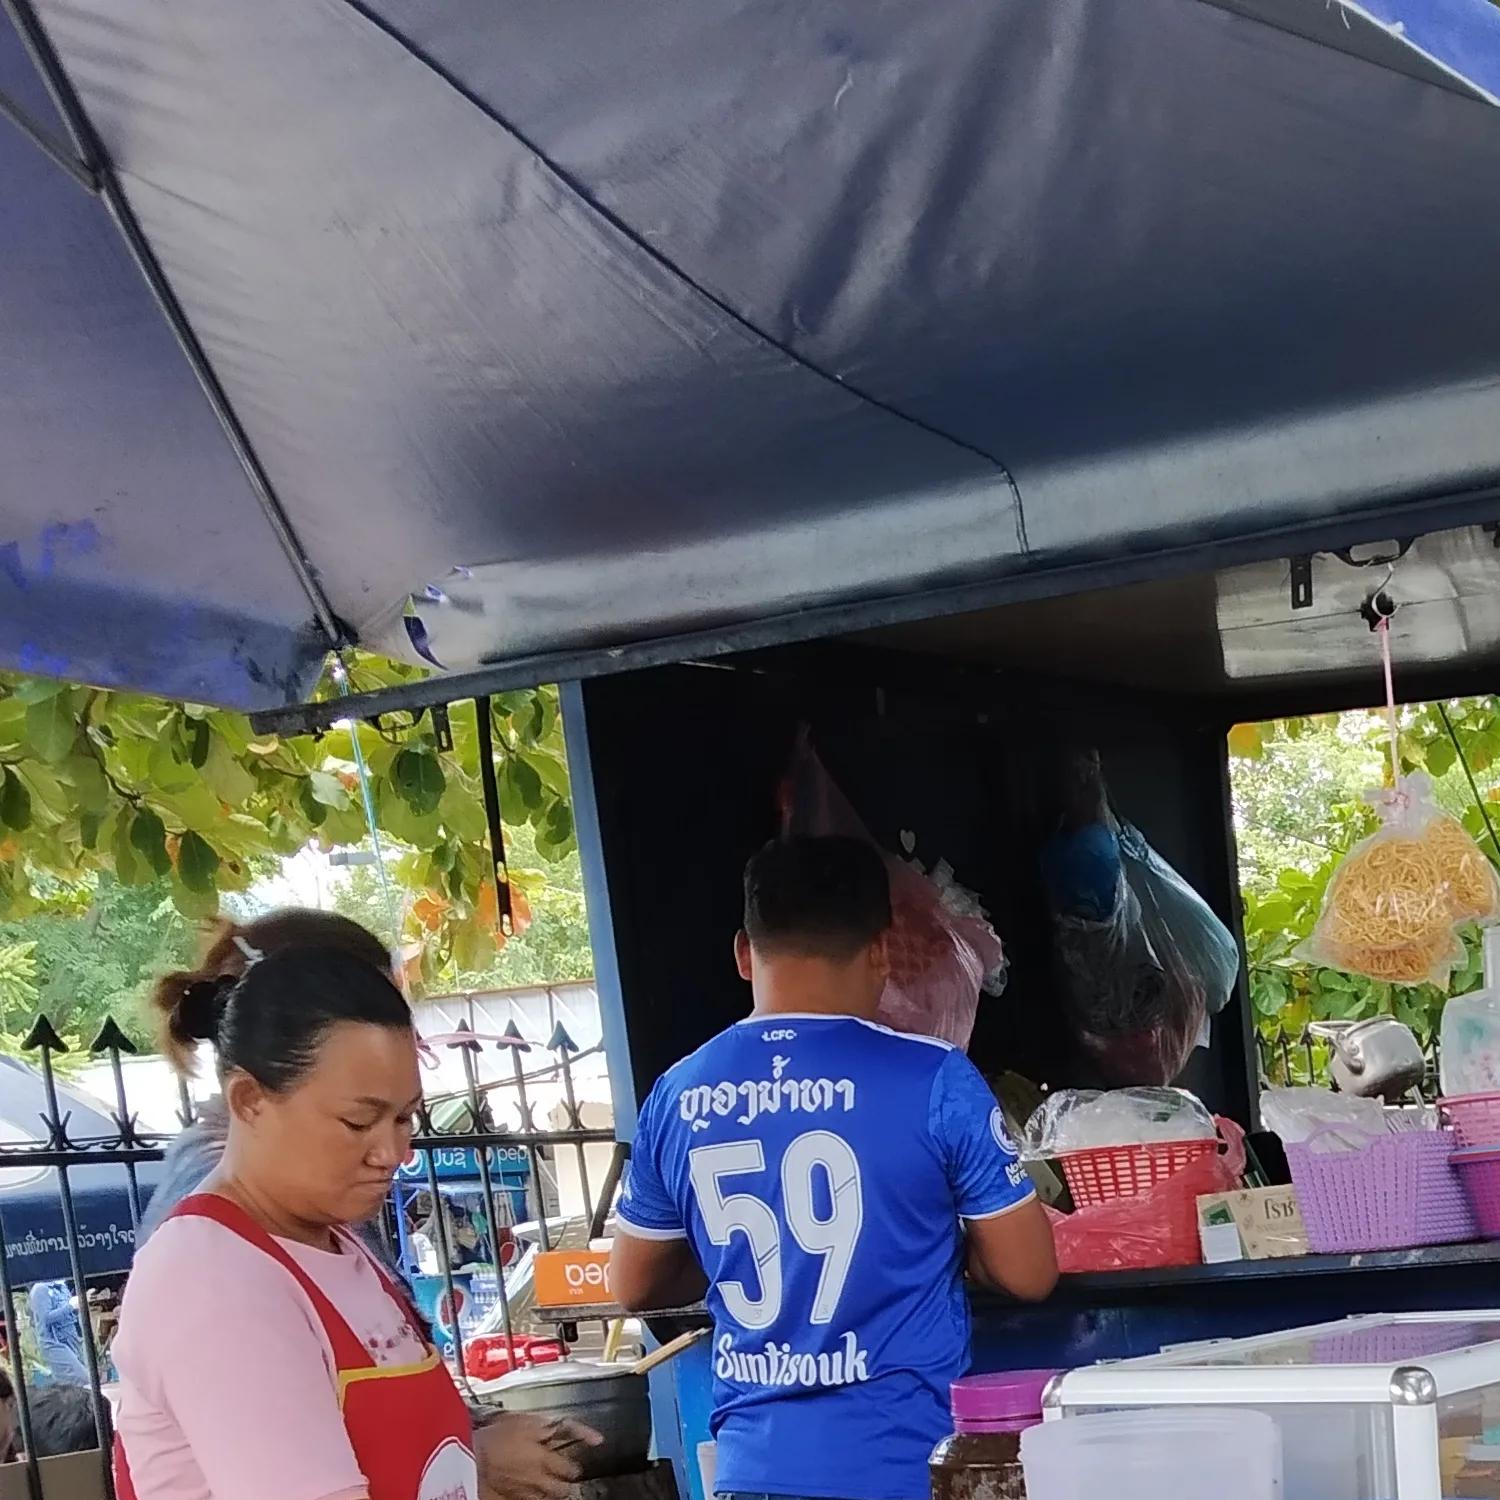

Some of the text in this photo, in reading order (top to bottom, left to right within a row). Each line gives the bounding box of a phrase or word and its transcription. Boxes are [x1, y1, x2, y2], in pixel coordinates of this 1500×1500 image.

[763, 1029, 796, 1041] LCFC
[497, 1146, 531, 1165] pep
[689, 1130, 862, 1330] 59
[716, 1331, 870, 1386] Suntisouk
